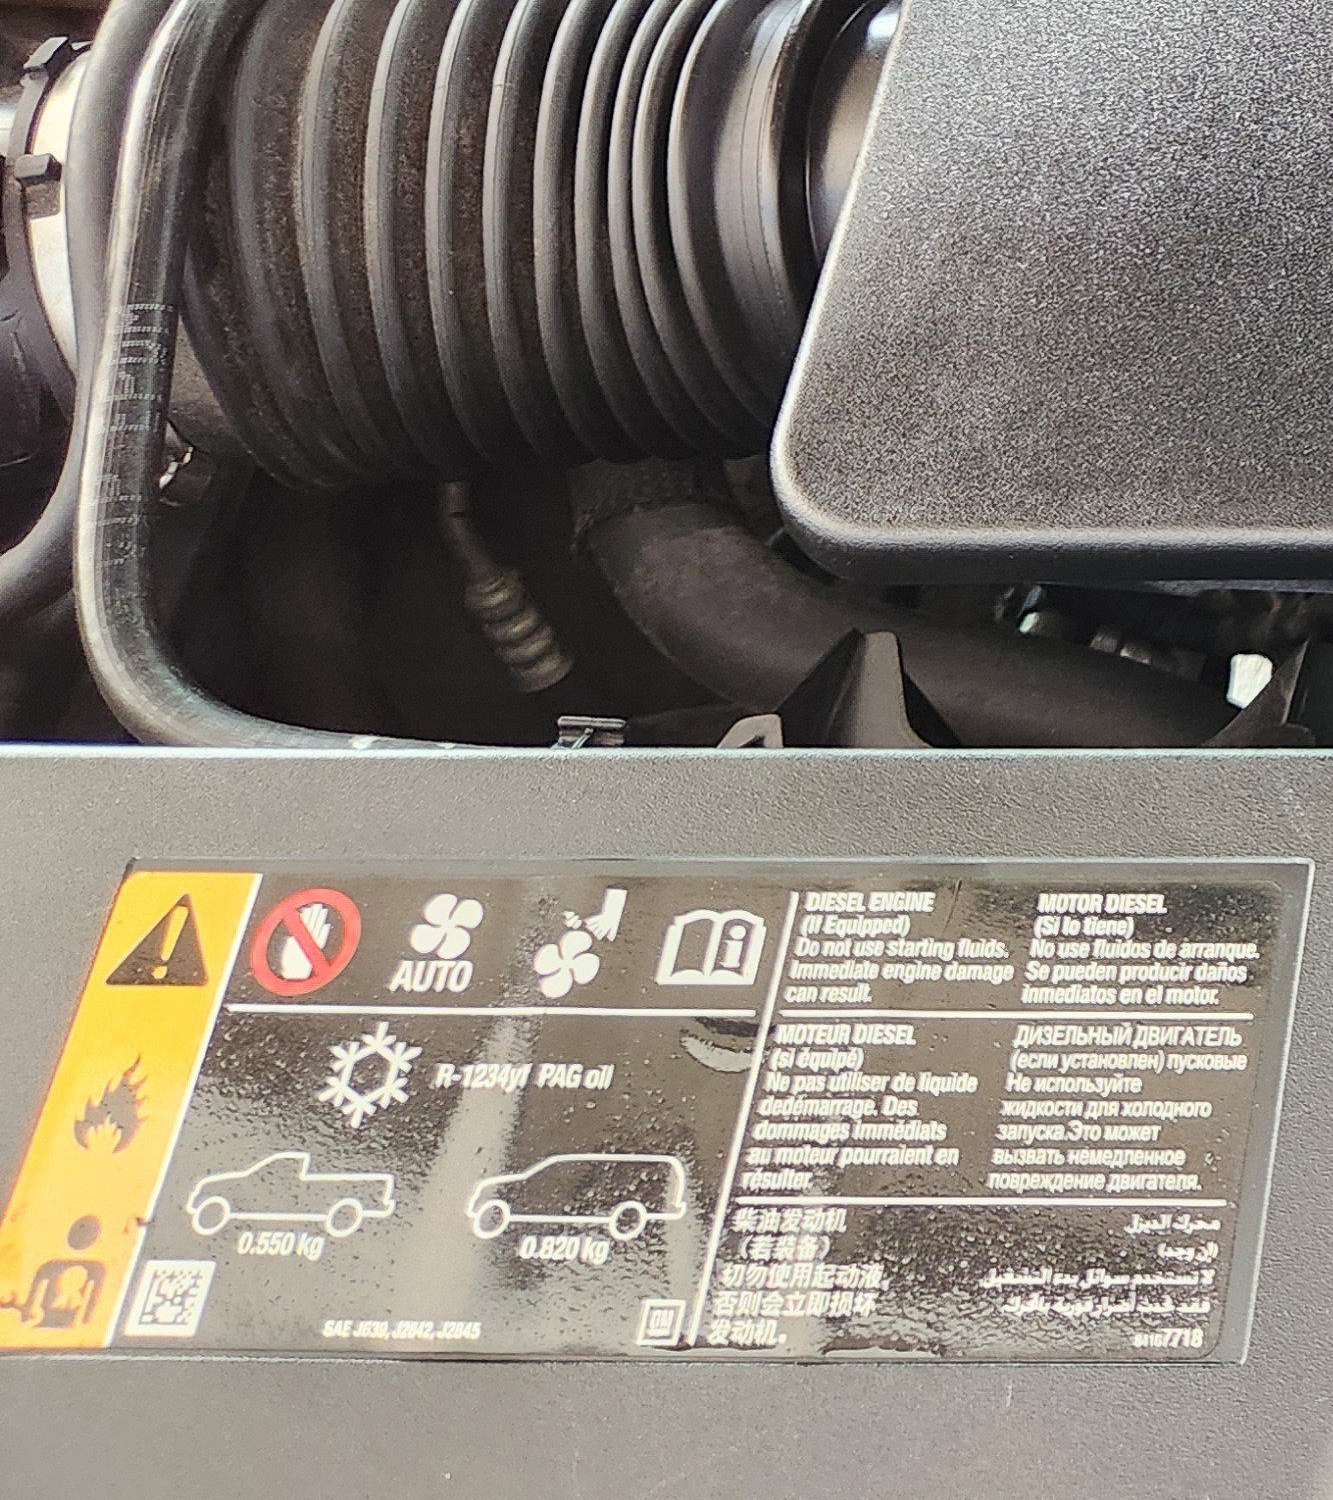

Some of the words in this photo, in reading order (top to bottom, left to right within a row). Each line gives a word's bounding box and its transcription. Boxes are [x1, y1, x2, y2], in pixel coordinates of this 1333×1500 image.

[804, 890, 867, 913] DIESEL
[868, 890, 937, 913] ENGINE
[1036, 892, 1104, 914] MOTOR
[1104, 892, 1168, 915] DIESEL
[822, 914, 912, 938] Equipped)
[1033, 915, 1060, 940] (Si
[1060, 916, 1082, 937] lo
[1082, 915, 1135, 940] tiene)
[794, 935, 821, 957] Do
[820, 937, 852, 957] not
[852, 940, 885, 957] use
[885, 937, 956, 961] starting
[955, 937, 1010, 960] fluids.
[1029, 937, 1056, 959] No
[1056, 941, 1091, 959] use
[1091, 938, 1152, 960] fluidos
[1152, 938, 1178, 960] de
[1178, 941, 1261, 963] arranque.
[387, 959, 474, 993] AUTO
[788, 959, 880, 981] Immediate
[880, 960, 943, 984] engine
[943, 960, 1015, 986] damage
[1024, 959, 1050, 982] Se
[1051, 961, 1118, 985] pueden
[1118, 961, 1194, 985] producir
[1193, 960, 1248, 983] daños
[783, 984, 819, 1003] can
[818, 982, 873, 1003] result.
[1020, 983, 1118, 1005] inmediatos
[1118, 987, 1144, 1006] en
[1144, 984, 1165, 1006] el
[1165, 985, 1220, 1006] motor.
[773, 1022, 851, 1046] MOTEUR
[851, 1023, 917, 1046] DIESEL
[1011, 1021, 1133, 1049] ДИЗЕЛЬНЫЙ
[1132, 1025, 1243, 1050] ДВИГАТЕЛЬ
[768, 1046, 797, 1072] (si
[1009, 1048, 1059, 1074] (если
[1058, 1048, 1166, 1075] установлен)
[1166, 1052, 1248, 1075] пусковые
[432, 1062, 534, 1094] R-1234yf
[536, 1062, 584, 1090] PAG
[583, 1063, 615, 1091] oil
[763, 1070, 791, 1093] Ne
[790, 1073, 827, 1095] pas
[826, 1070, 891, 1093] utiliser
[890, 1071, 917, 1093] de
[916, 1070, 979, 1097] liquide
[1003, 1071, 1033, 1093] Не
[1032, 1071, 1143, 1098] используйте
[998, 1099, 1084, 1120] жидкости
[1084, 1100, 1120, 1120] для
[1120, 1100, 1213, 1120] холодного
[752, 1120, 850, 1145] dommages
[850, 1118, 948, 1142] immédiats
[1102, 1124, 1163, 1142] может
[745, 1146, 773, 1166] au
[772, 1144, 840, 1166] moteur
[837, 1143, 935, 1169] pourraient
[934, 1147, 961, 1166] en
[990, 1148, 1066, 1167] вызвать
[1066, 1149, 1187, 1169] немедленное
[986, 1172, 1107, 1194] повреждение
[1106, 1173, 1203, 1194] двигателя.
[732, 1207, 848, 1234] 柴油发动机
[236, 1231, 296, 1256] 0.550
[298, 1233, 326, 1263] kg
[517, 1235, 581, 1261] 0.820
[582, 1237, 610, 1265] kg
[713, 1290, 879, 1318] 否则会立即损坏
[322, 1319, 353, 1339] SAE
[706, 1319, 787, 1347] 发动机。
